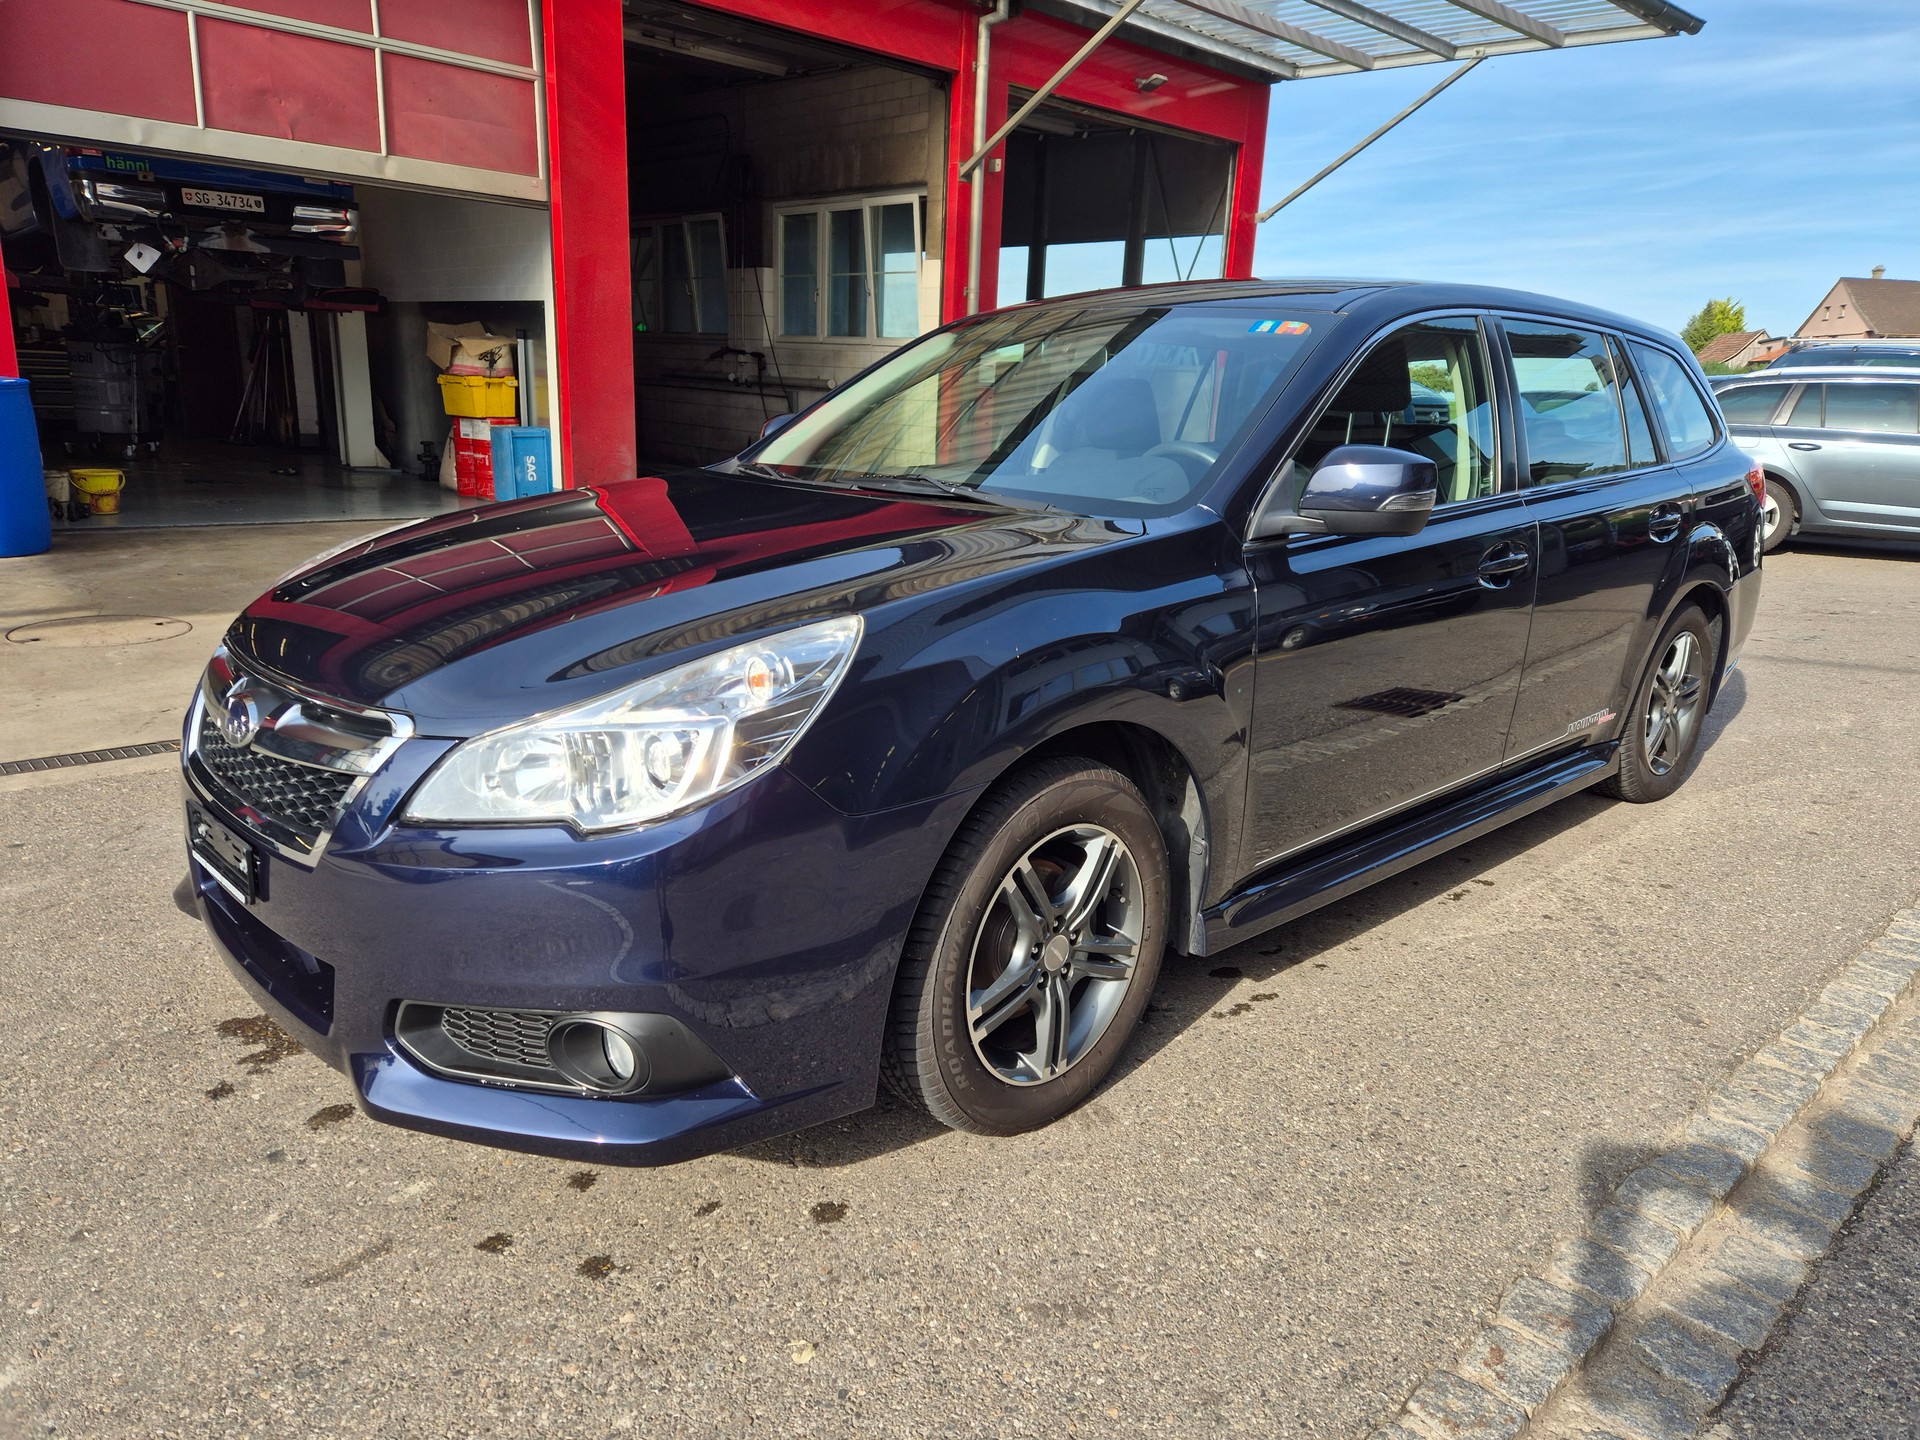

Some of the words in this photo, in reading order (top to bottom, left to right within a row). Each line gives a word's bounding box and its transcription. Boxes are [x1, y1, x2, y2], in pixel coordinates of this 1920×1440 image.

[105, 156, 150, 172] hänni
[526, 455, 537, 482] SAG
[941, 921, 969, 1090] ROADHAWK
